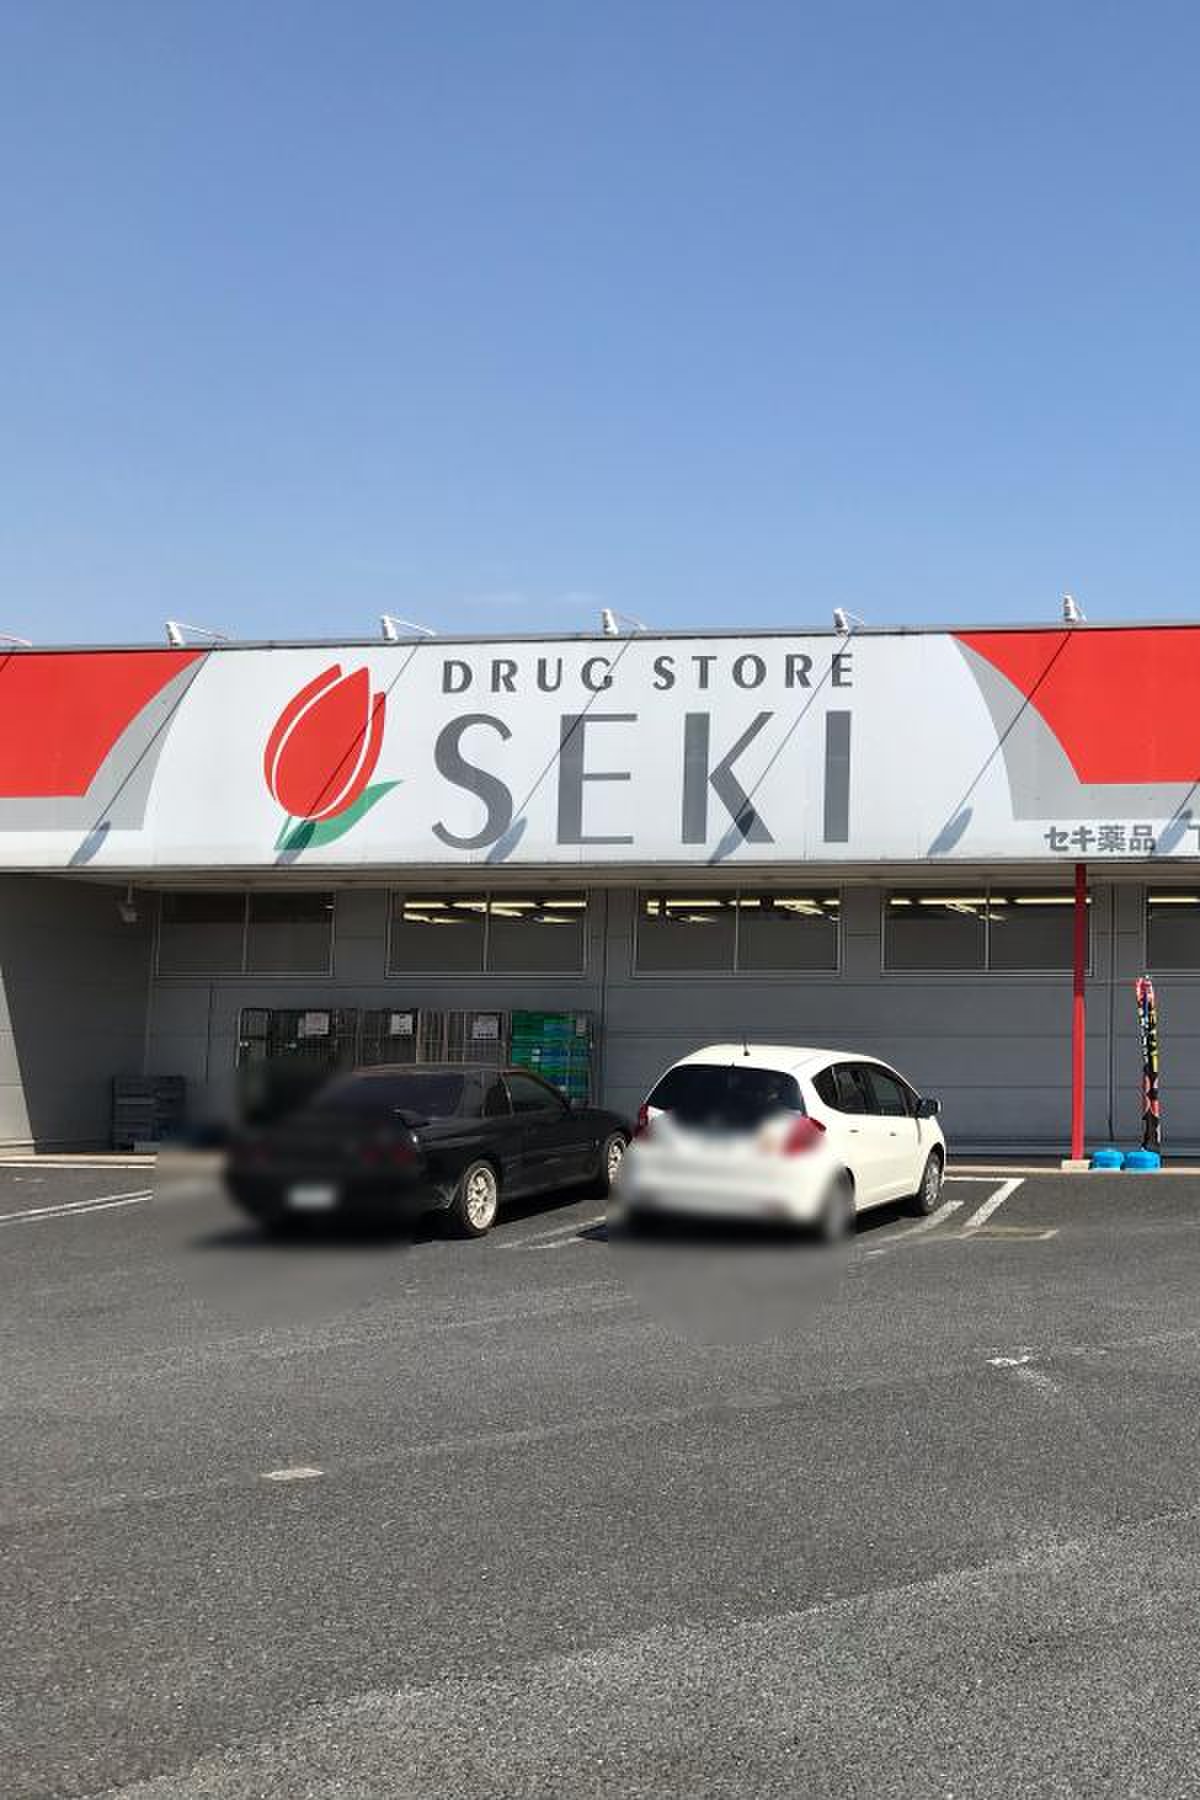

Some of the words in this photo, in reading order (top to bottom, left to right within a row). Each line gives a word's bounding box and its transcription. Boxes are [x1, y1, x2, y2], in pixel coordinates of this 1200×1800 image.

[442, 657, 613, 694] DRUG
[652, 653, 854, 691] STORE
[432, 710, 852, 850] SEKI
[1044, 824, 1156, 852] セキ薬品
